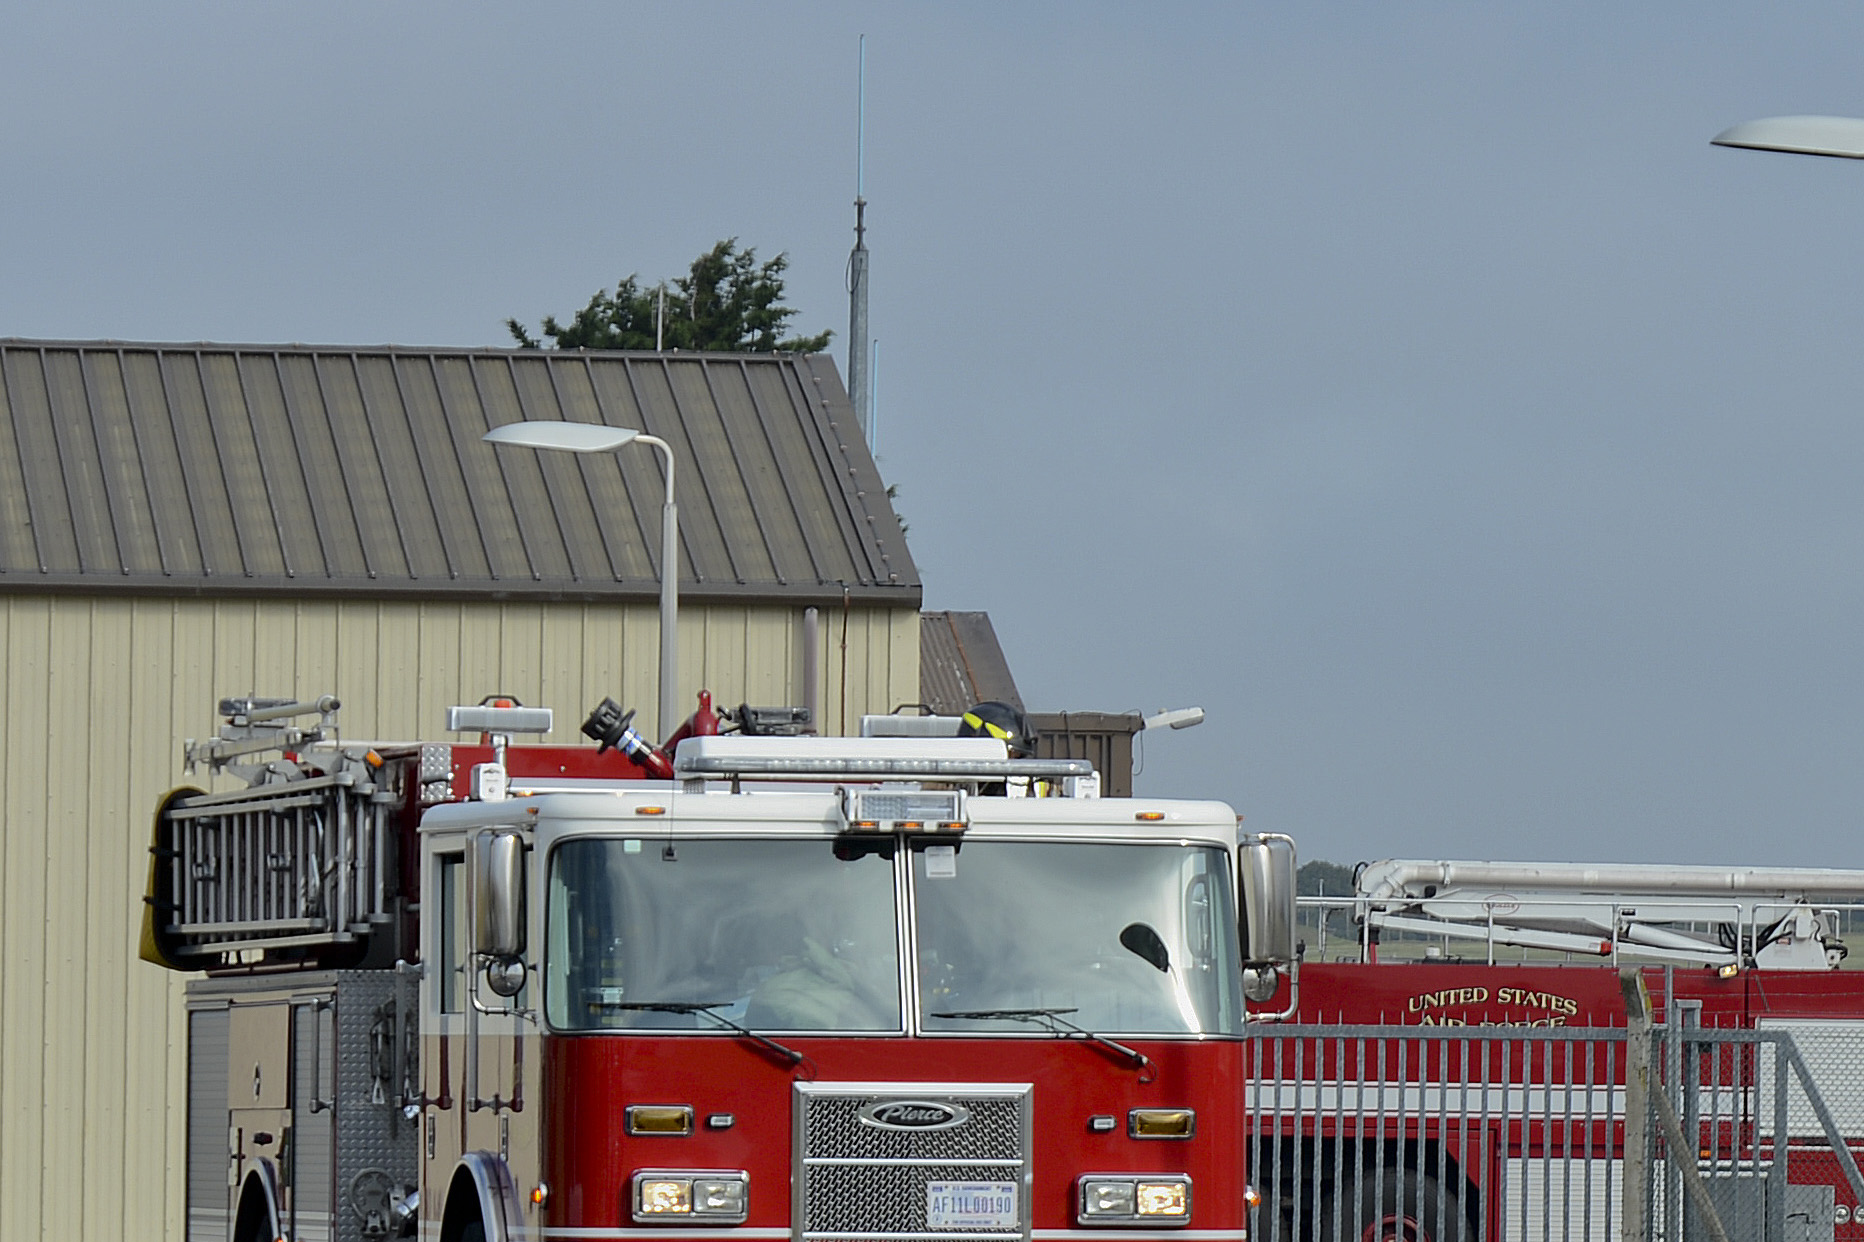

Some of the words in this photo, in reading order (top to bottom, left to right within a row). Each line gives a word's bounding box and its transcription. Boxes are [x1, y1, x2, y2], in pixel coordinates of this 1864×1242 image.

[1408, 987, 1489, 1013] UNITED
[1497, 987, 1578, 1016] STATES
[881, 1105, 944, 1121] Pierce
[932, 1196, 1012, 1213] AF11L00190
